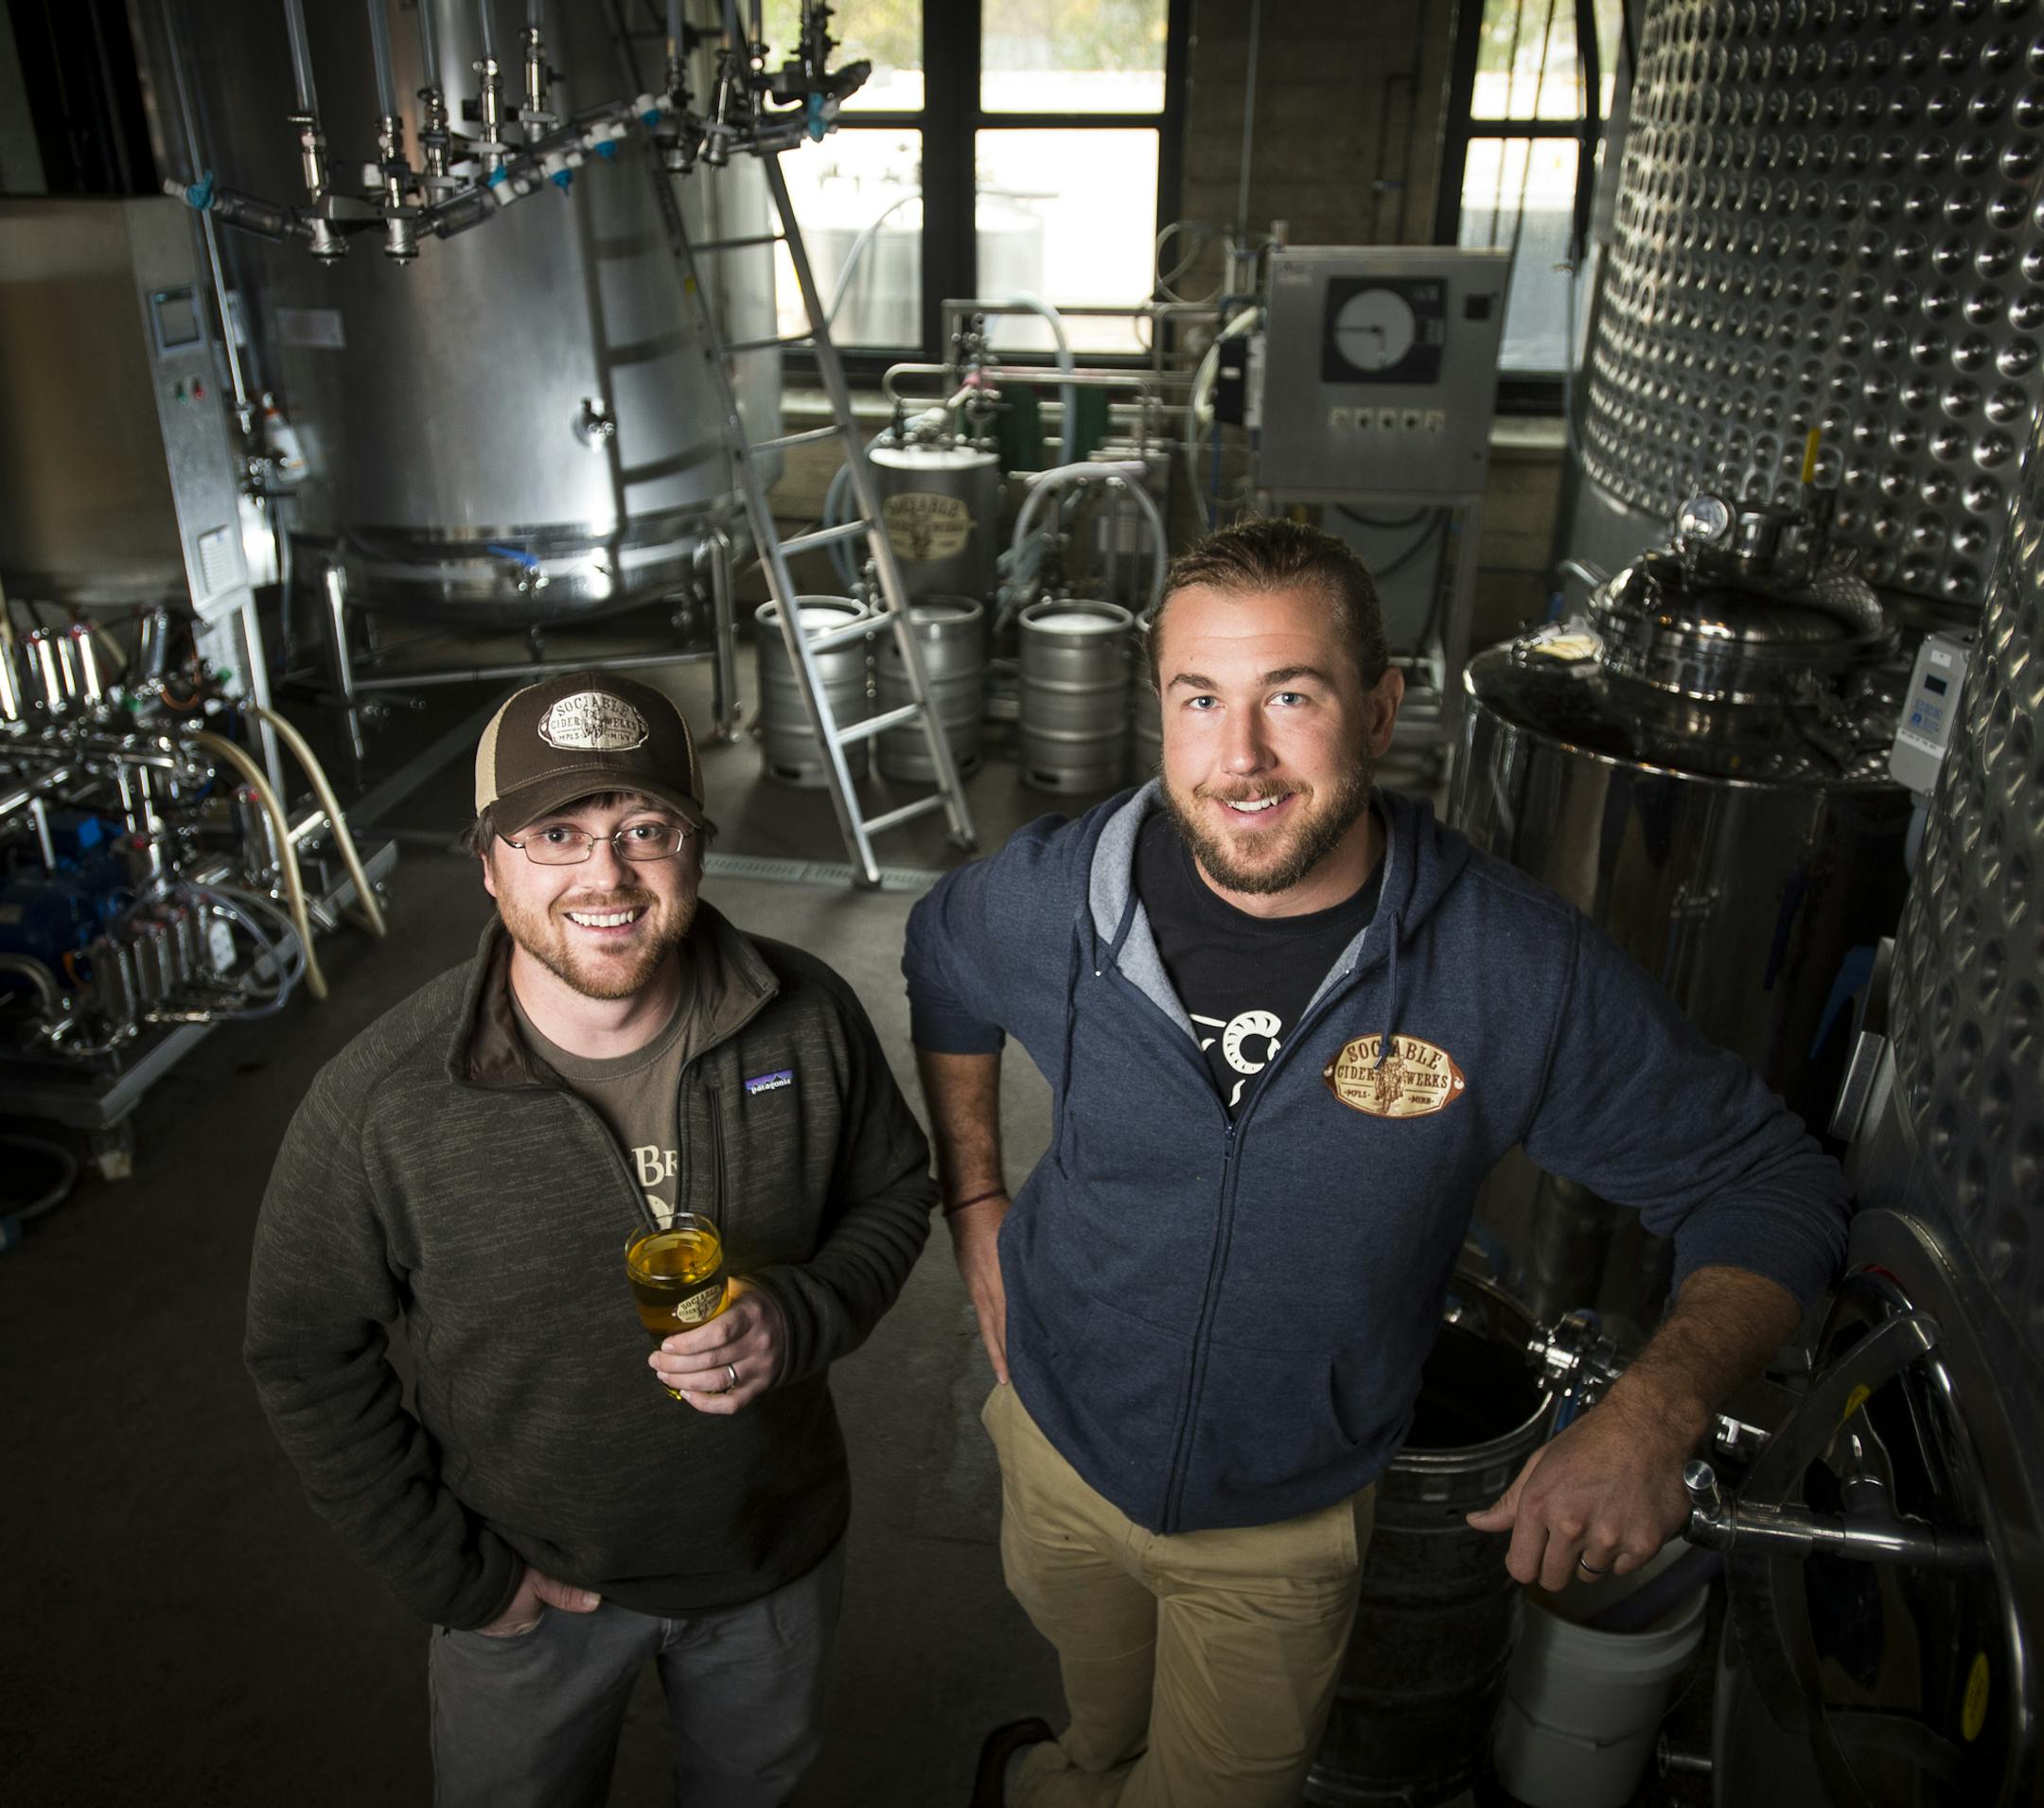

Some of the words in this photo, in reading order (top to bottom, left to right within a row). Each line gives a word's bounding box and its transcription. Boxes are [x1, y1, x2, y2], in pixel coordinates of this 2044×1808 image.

[556, 695, 630, 717] SOCIABLE
[551, 717, 581, 729] CIDER
[1347, 1040, 1443, 1071] SOCABLE
[751, 1077, 791, 1096] patagonia
[1337, 1065, 1375, 1081] CIDER
[1407, 1071, 1449, 1089] WERKS
